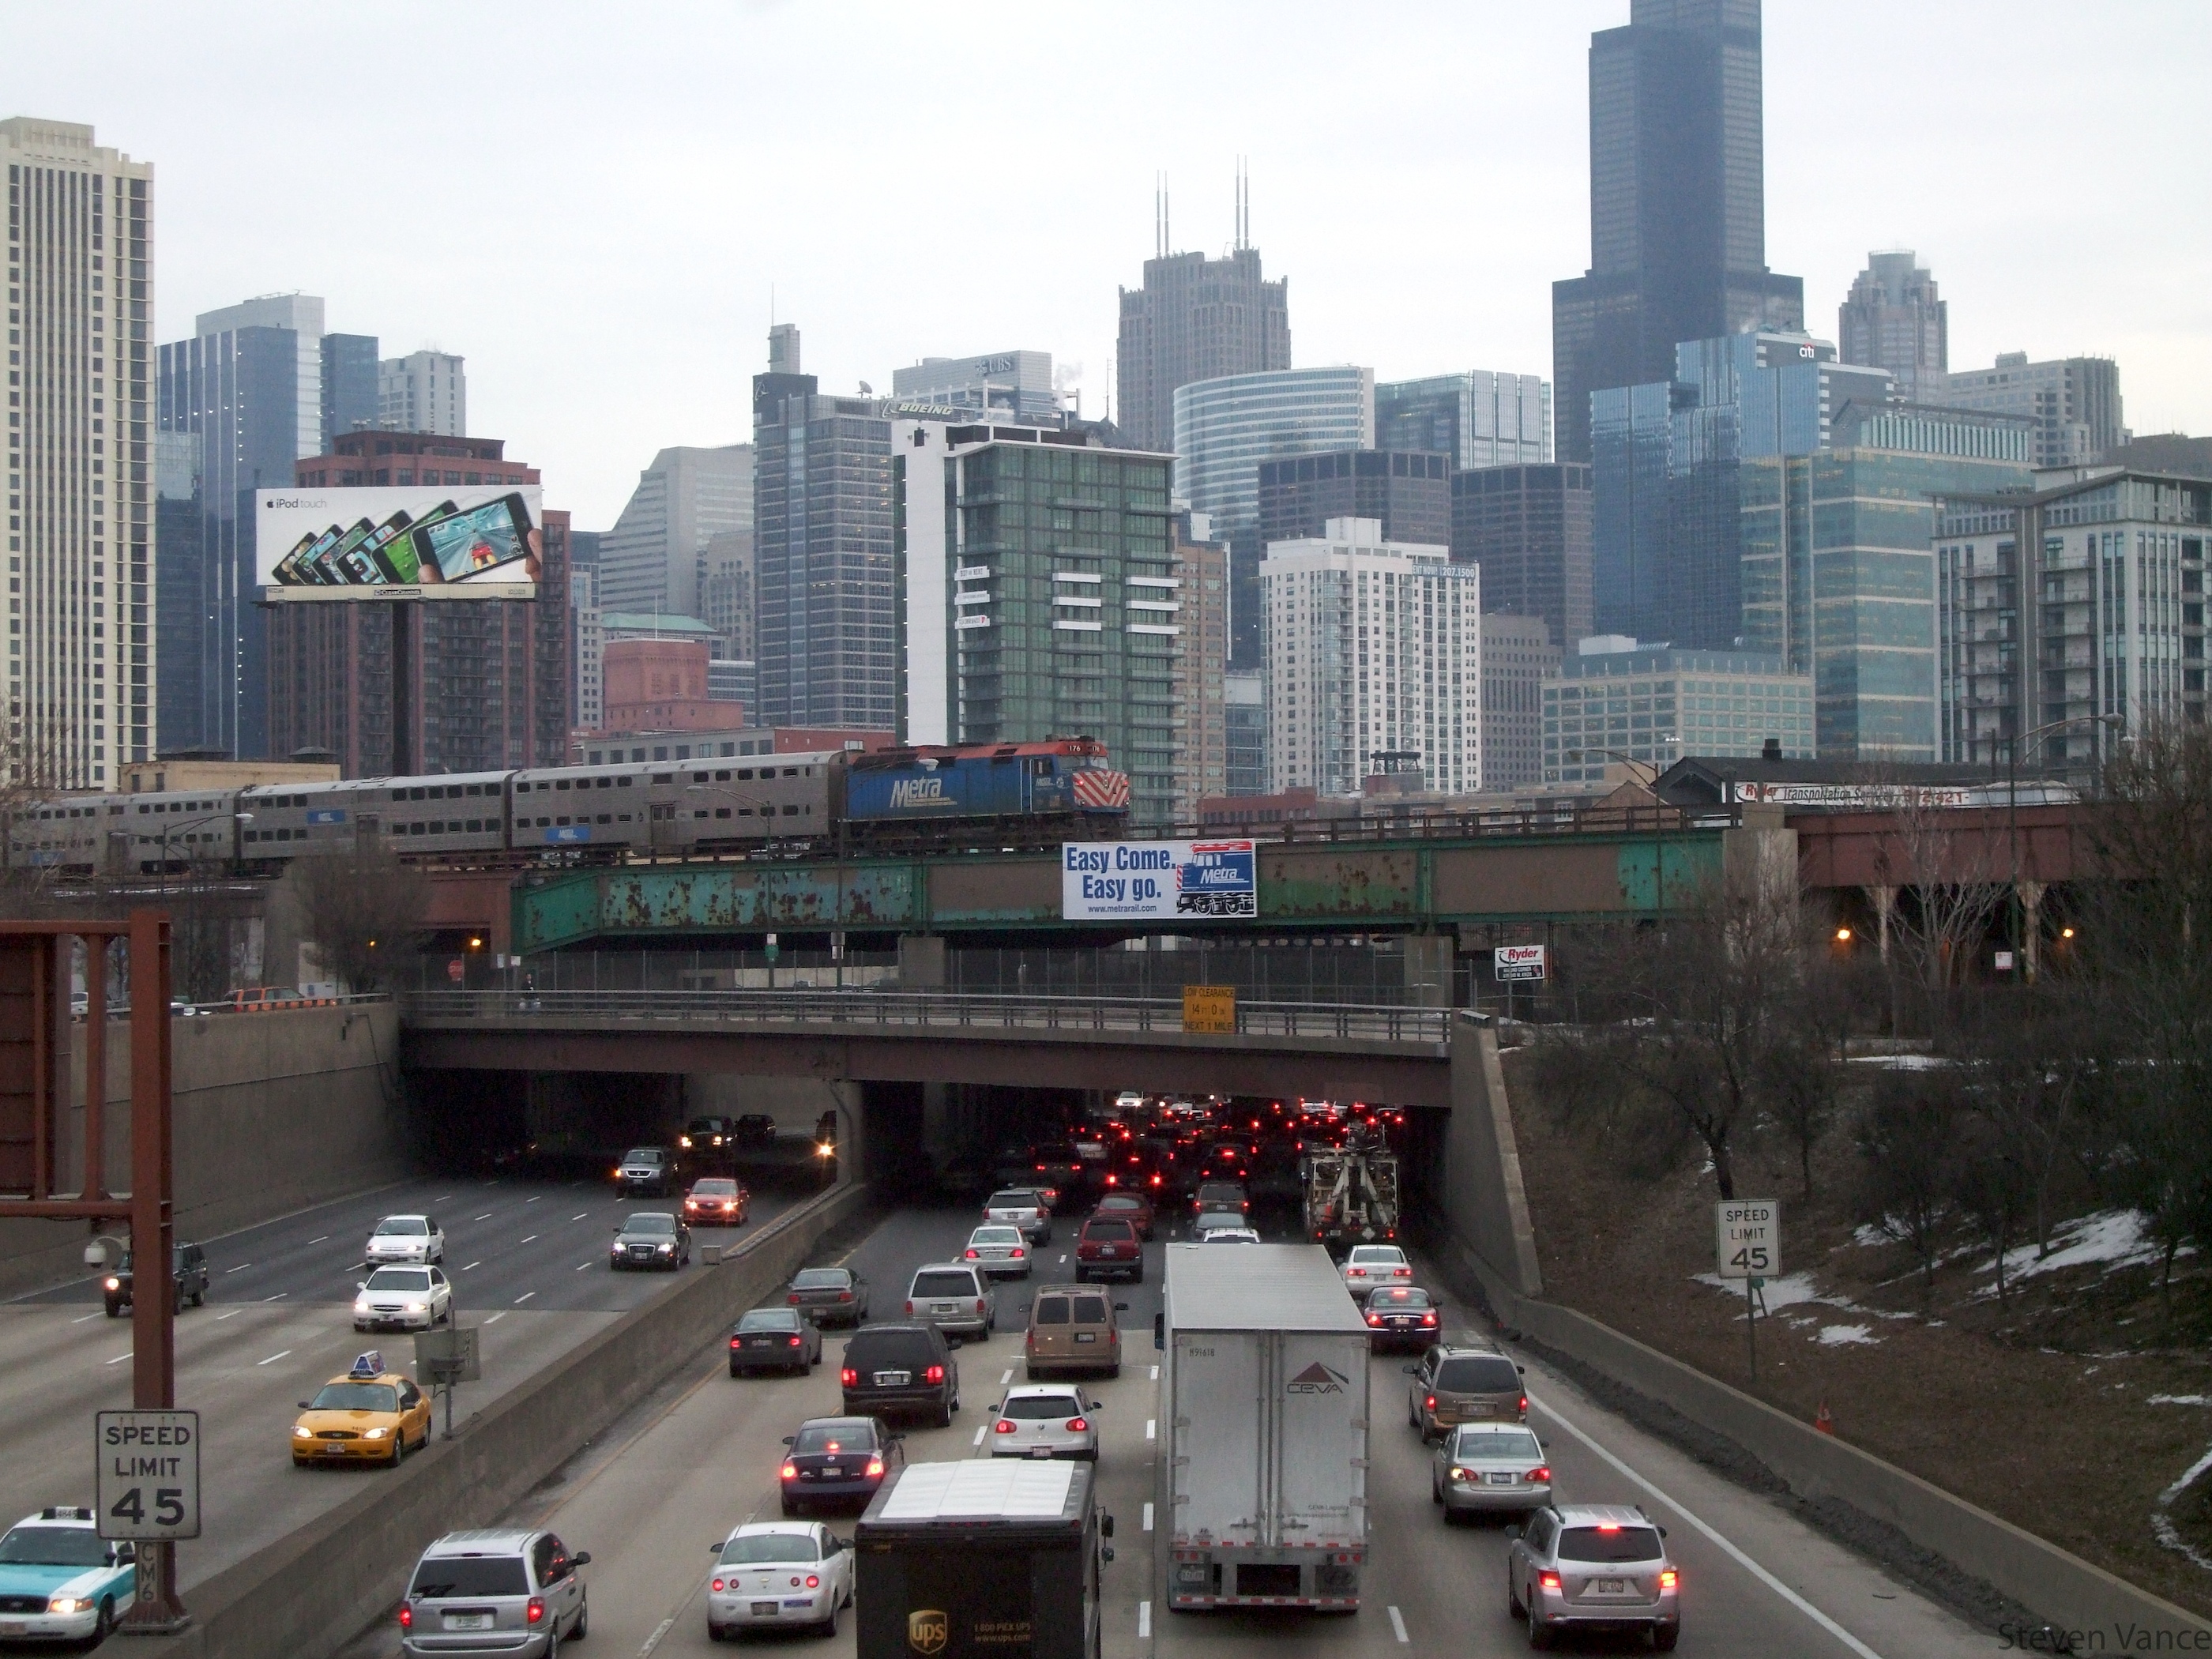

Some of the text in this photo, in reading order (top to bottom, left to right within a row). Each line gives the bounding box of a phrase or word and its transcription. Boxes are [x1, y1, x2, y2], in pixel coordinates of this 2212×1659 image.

[1799, 346, 1815, 358] citi
[989, 358, 1011, 372] UBS
[898, 403, 953, 415] BOEING
[276, 498, 327, 508] iPod touch
[1443, 566, 1475, 577] 207.1500
[890, 776, 942, 807] Metra
[1066, 846, 1176, 873] Easy Come.
[1200, 867, 1238, 884] Metra
[1082, 875, 1161, 901] Easy go.
[1088, 905, 1157, 913] www.metrarail.com
[1507, 948, 1539, 961] Ryder
[1185, 1021, 1205, 1030] NEXT
[1725, 1209, 1769, 1222] SPEED
[1731, 1228, 1765, 1240] LIMIT
[1730, 1247, 1769, 1270] 45
[1287, 1383, 1343, 1394] CEVA
[106, 1426, 190, 1446] SPEED
[115, 1458, 181, 1477] LIMIT
[111, 1488, 185, 1526] 45
[912, 1623, 945, 1647] ups
